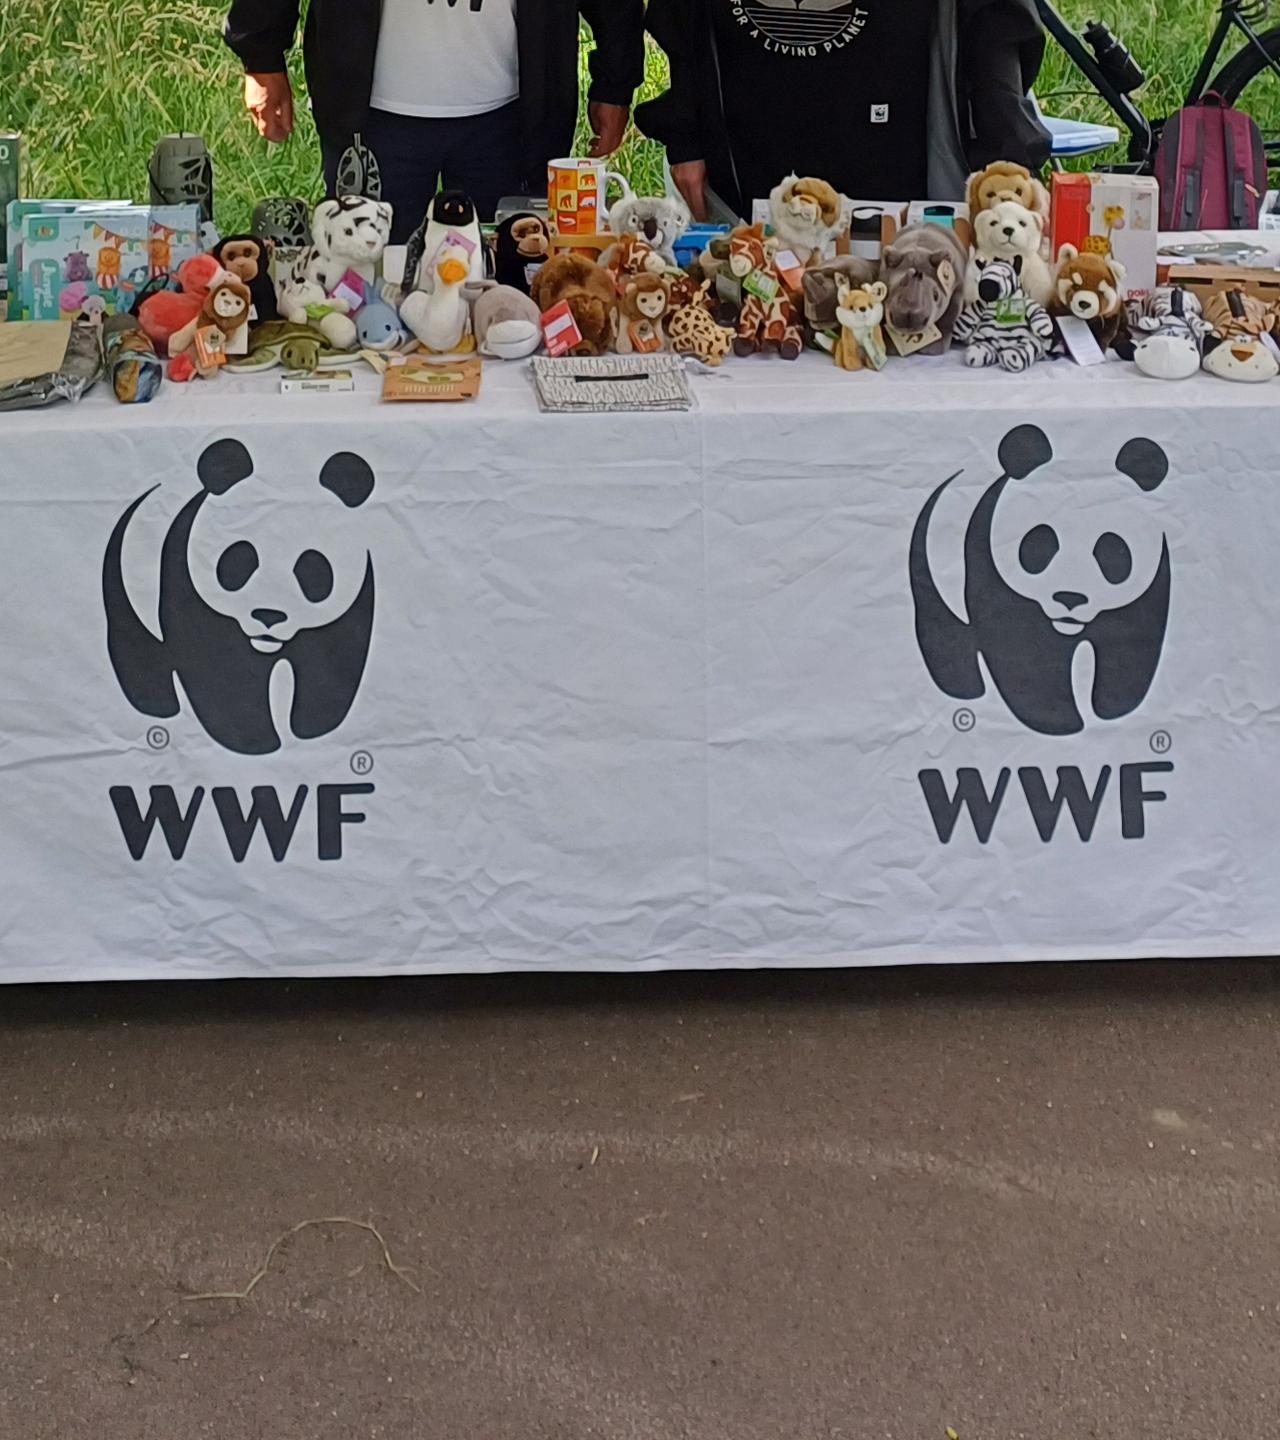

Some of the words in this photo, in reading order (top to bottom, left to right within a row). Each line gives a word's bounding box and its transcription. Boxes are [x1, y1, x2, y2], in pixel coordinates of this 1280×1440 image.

[749, 29, 759, 39] A
[764, 40, 817, 57] LIVING
[824, 8, 869, 53] PLANET
[109, 783, 375, 862] WWF
[918, 761, 1174, 844] WWF
